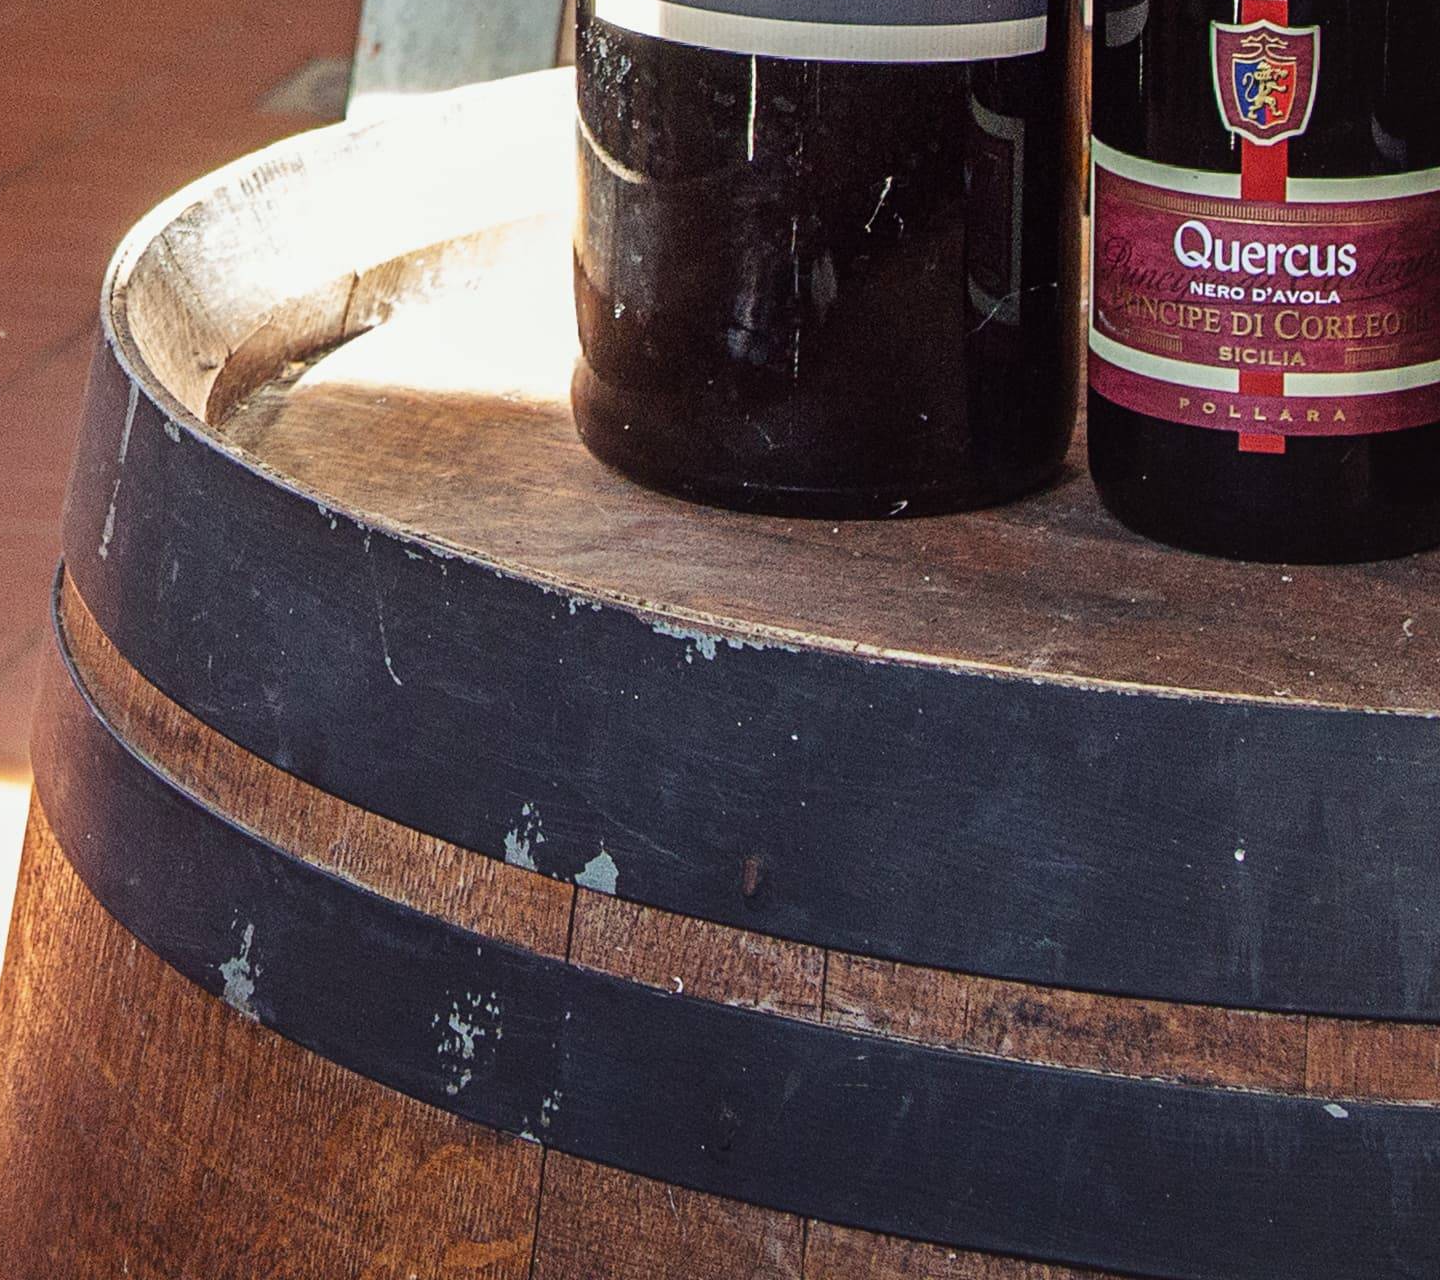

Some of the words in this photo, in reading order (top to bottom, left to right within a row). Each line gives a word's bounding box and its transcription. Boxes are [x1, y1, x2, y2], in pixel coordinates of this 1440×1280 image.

[1173, 219, 1358, 277] Quercus
[1189, 281, 1245, 301] NERO
[1252, 287, 1342, 305] D'AVOLA
[1112, 288, 1221, 334] RINCIPE
[1231, 311, 1265, 338] DI
[1273, 309, 1422, 341] CORLEO
[1218, 345, 1307, 367] SICILIA
[1178, 395, 1347, 424] POLLARA
